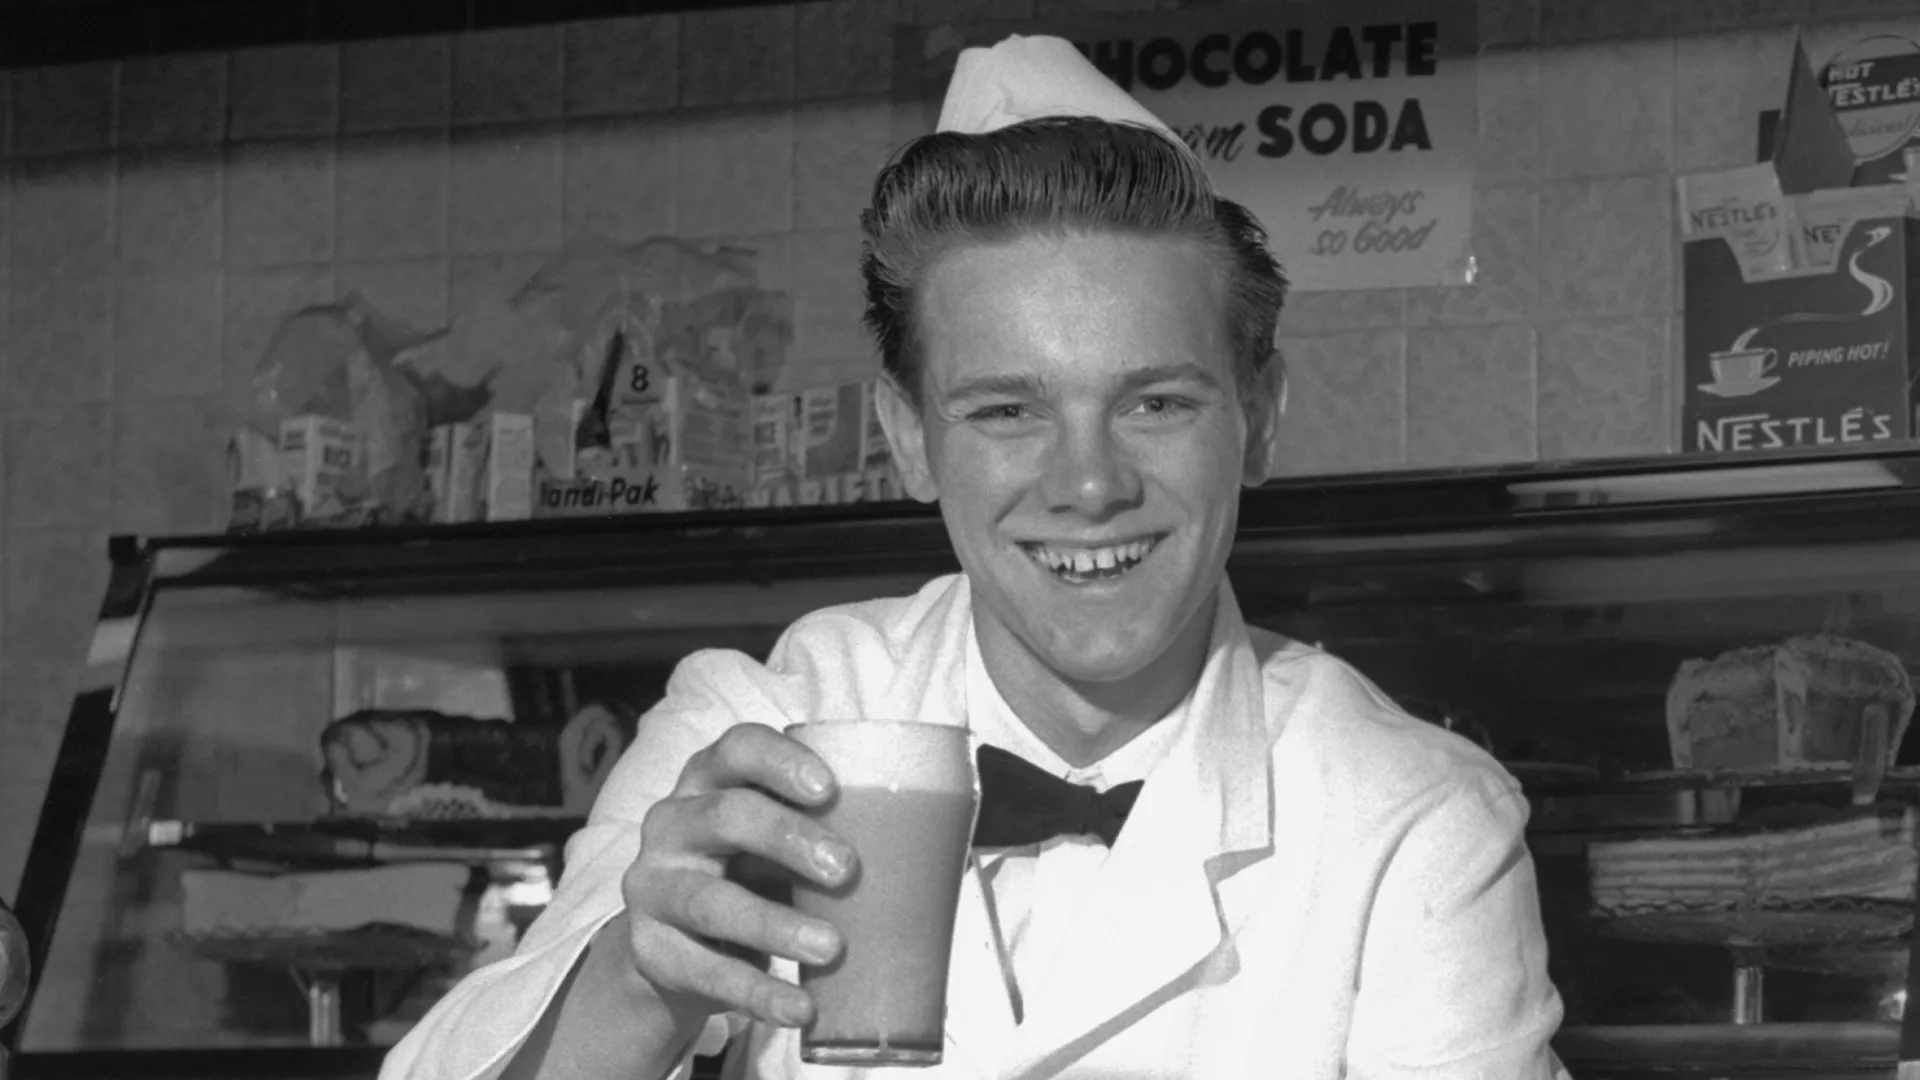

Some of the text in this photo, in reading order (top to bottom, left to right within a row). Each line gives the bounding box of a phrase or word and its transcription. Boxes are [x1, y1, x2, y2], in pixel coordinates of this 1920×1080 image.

[1074, 22, 1438, 91] HOCOLATE
[1256, 98, 1433, 158] SODA
[1307, 184, 1426, 224] Always
[1353, 219, 1438, 254] Good
[1787, 341, 1890, 368] PIPING HOT!
[631, 363, 650, 393] 8
[751, 471, 897, 507] VARIET
